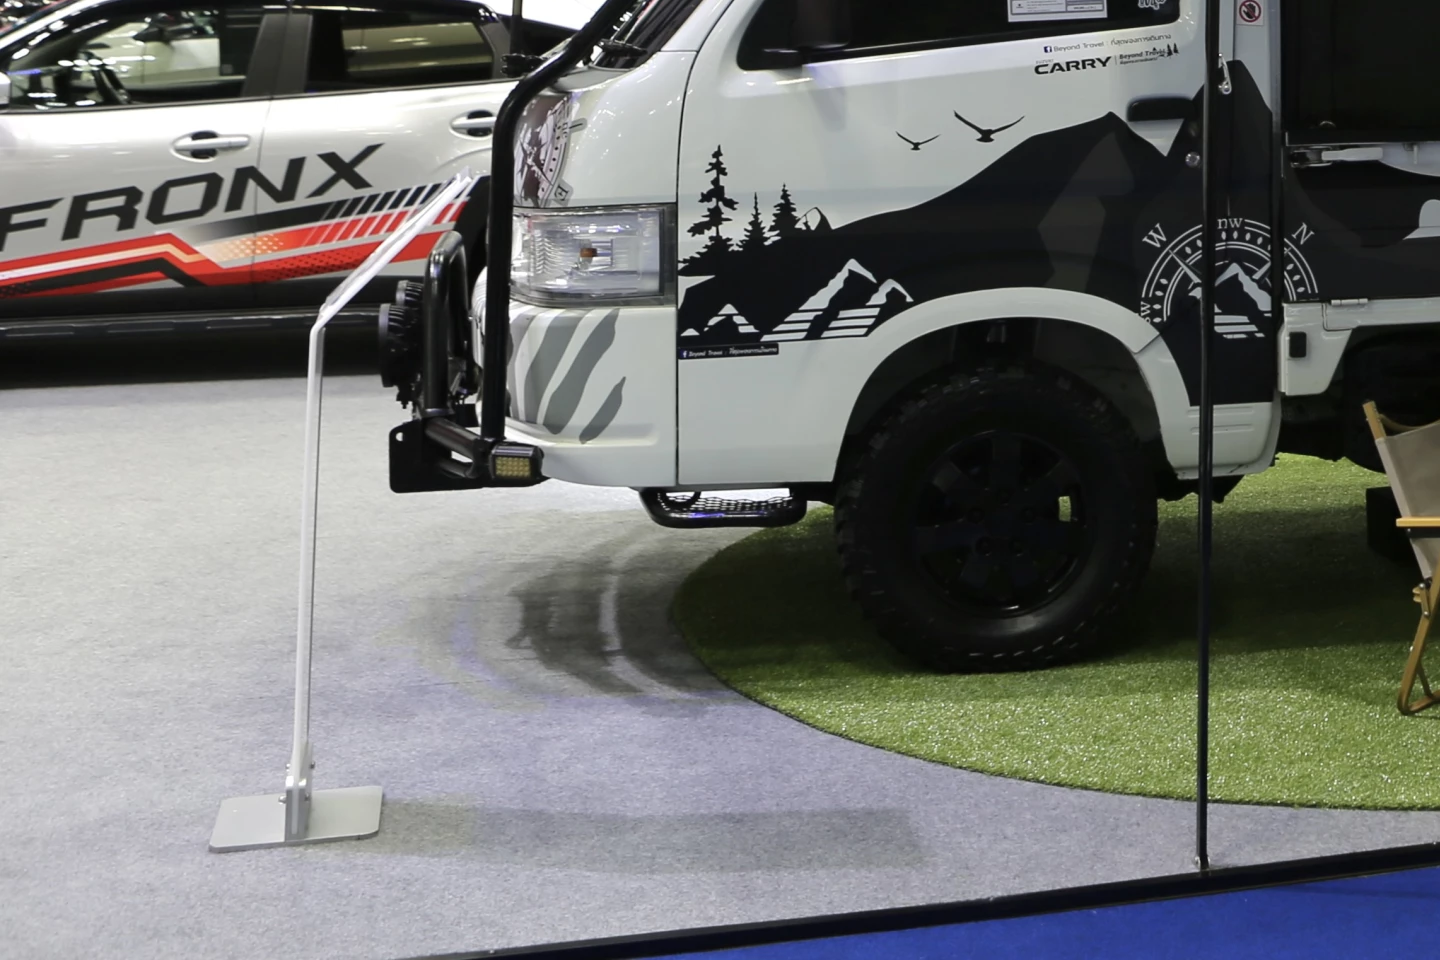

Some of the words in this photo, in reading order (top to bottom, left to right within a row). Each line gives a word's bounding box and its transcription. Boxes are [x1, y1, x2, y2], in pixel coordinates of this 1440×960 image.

[1053, 44, 1081, 52] Beyond
[1119, 51, 1143, 60] Beyond
[1034, 56, 1112, 75] CARRY
[0, 142, 386, 253] FRONX
[1142, 223, 1167, 248] W
[1292, 222, 1314, 245] N
